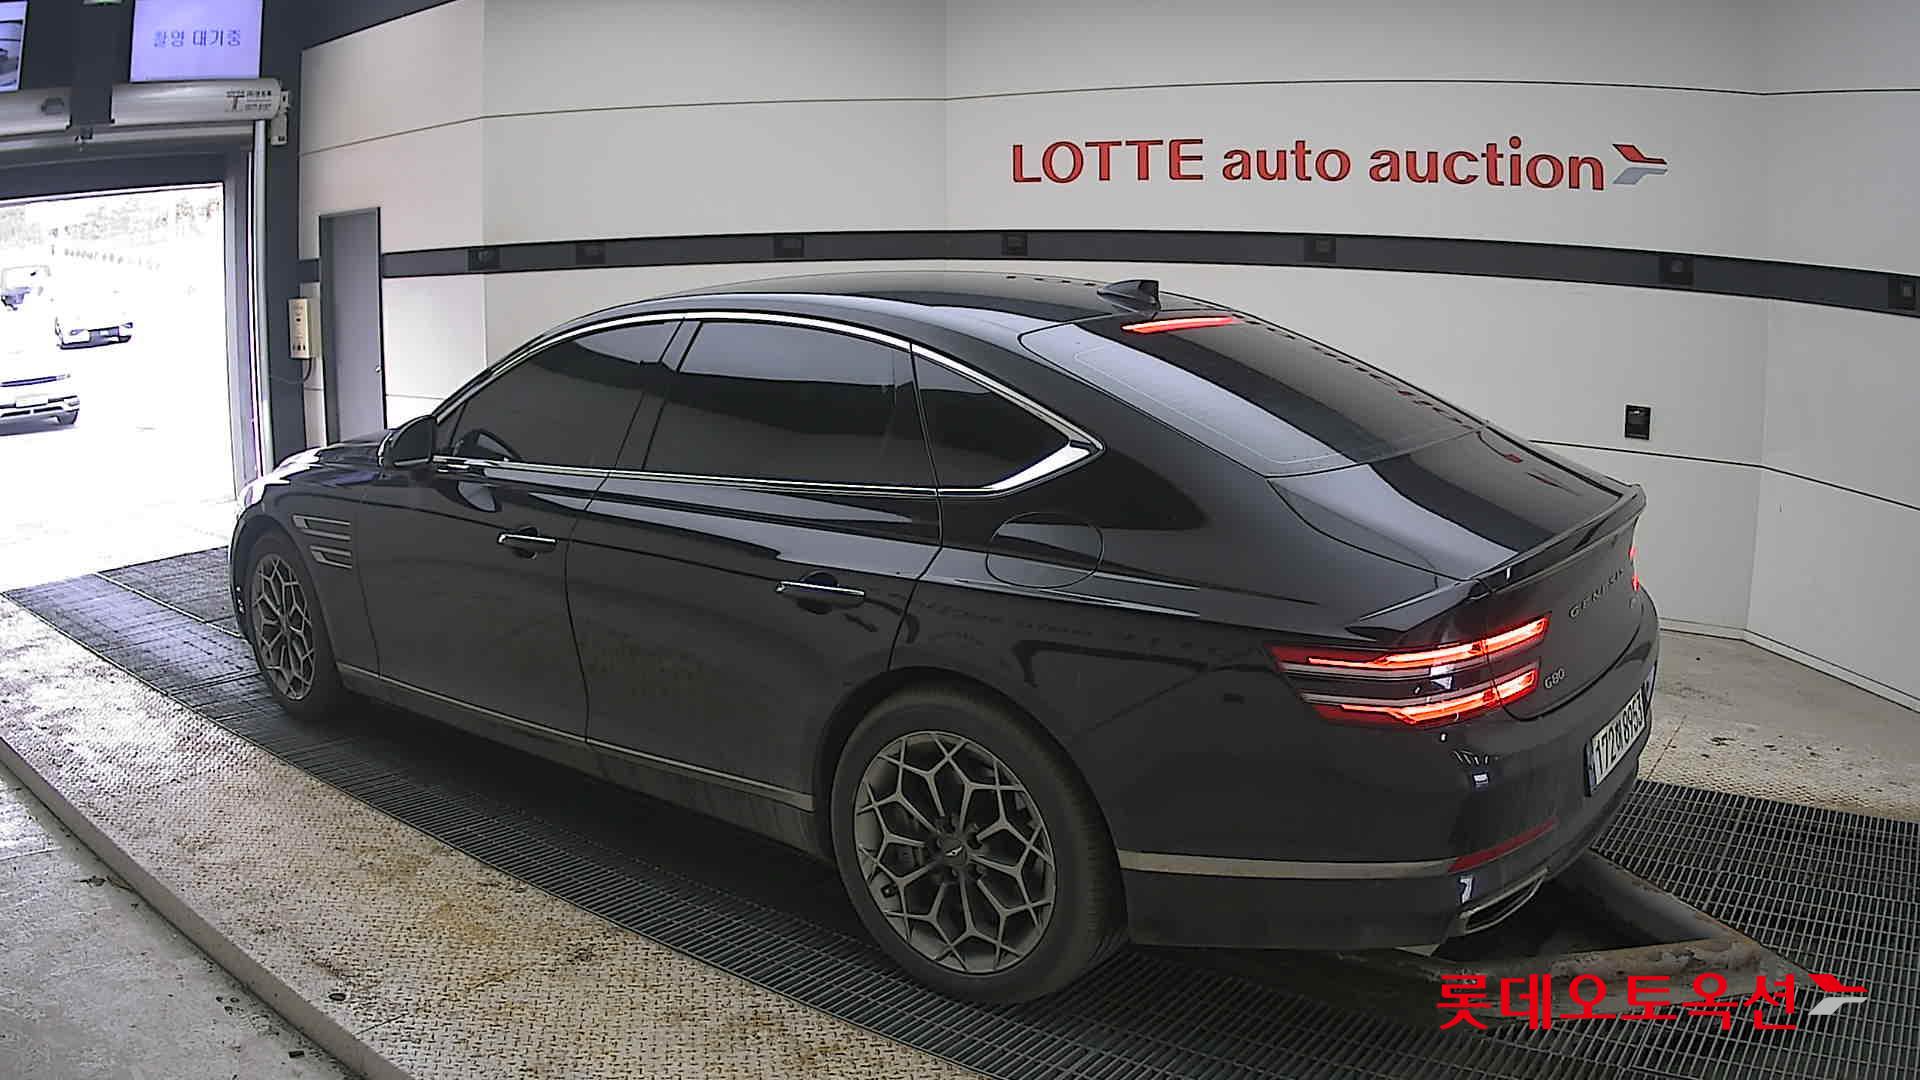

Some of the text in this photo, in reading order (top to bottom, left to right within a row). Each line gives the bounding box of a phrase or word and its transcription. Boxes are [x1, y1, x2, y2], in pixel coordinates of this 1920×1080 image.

[192, 30, 241, 47] 대기중
[1013, 138, 1605, 190] LOTTE auto auction
[1543, 668, 1566, 690] G80
